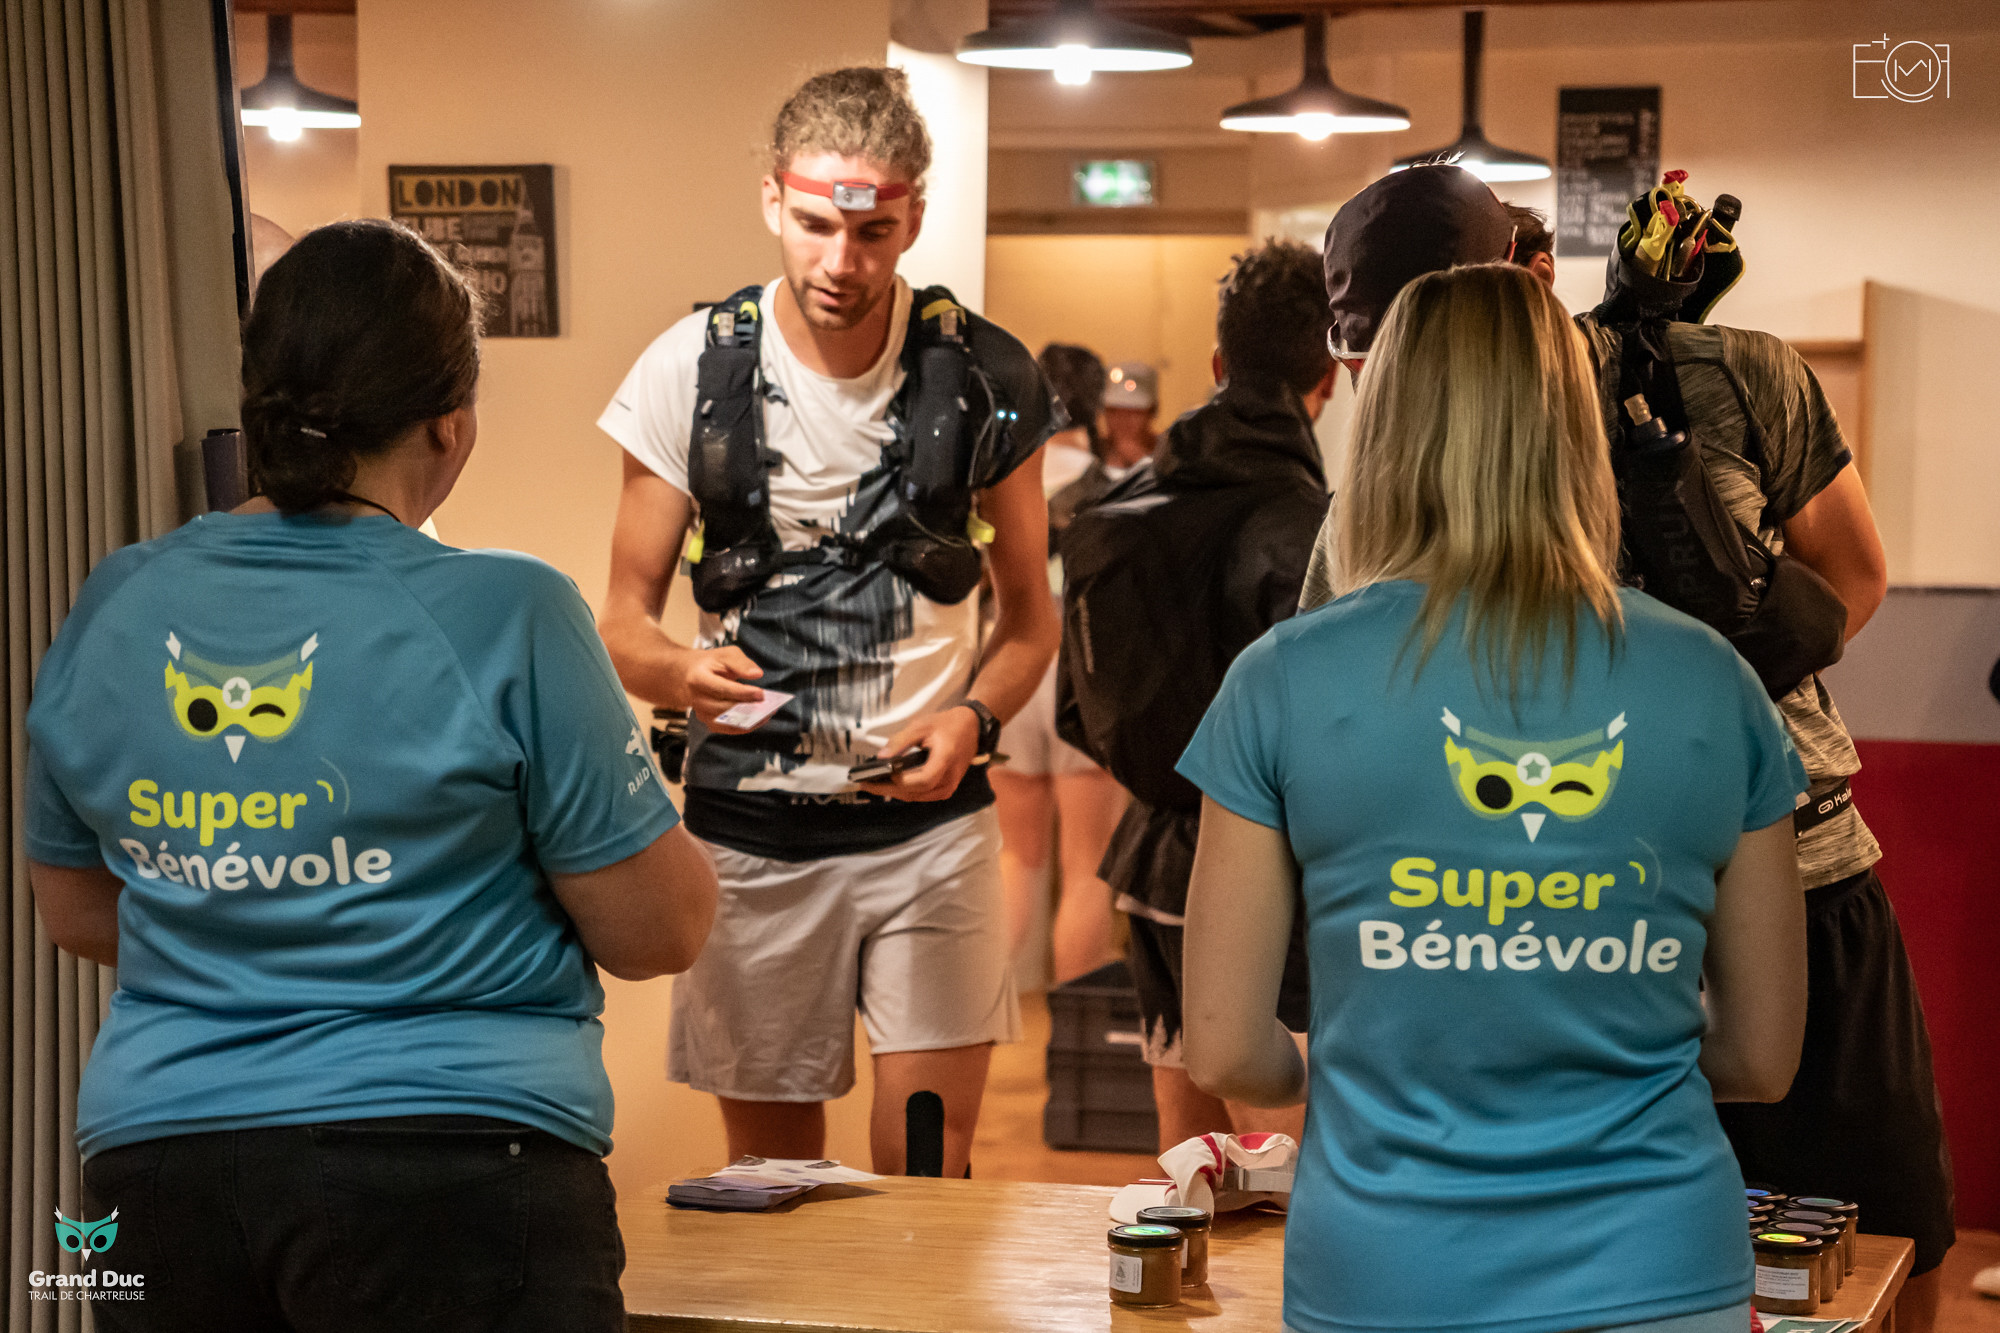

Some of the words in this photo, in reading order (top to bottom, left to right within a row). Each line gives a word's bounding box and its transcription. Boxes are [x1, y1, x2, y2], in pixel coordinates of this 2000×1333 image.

[399, 178, 521, 207] LONDON
[627, 766, 651, 796] RAID
[128, 778, 308, 847] Super
[119, 835, 393, 891] Bénévole
[1389, 856, 1616, 926] Super
[1358, 918, 1683, 975] Bénévole
